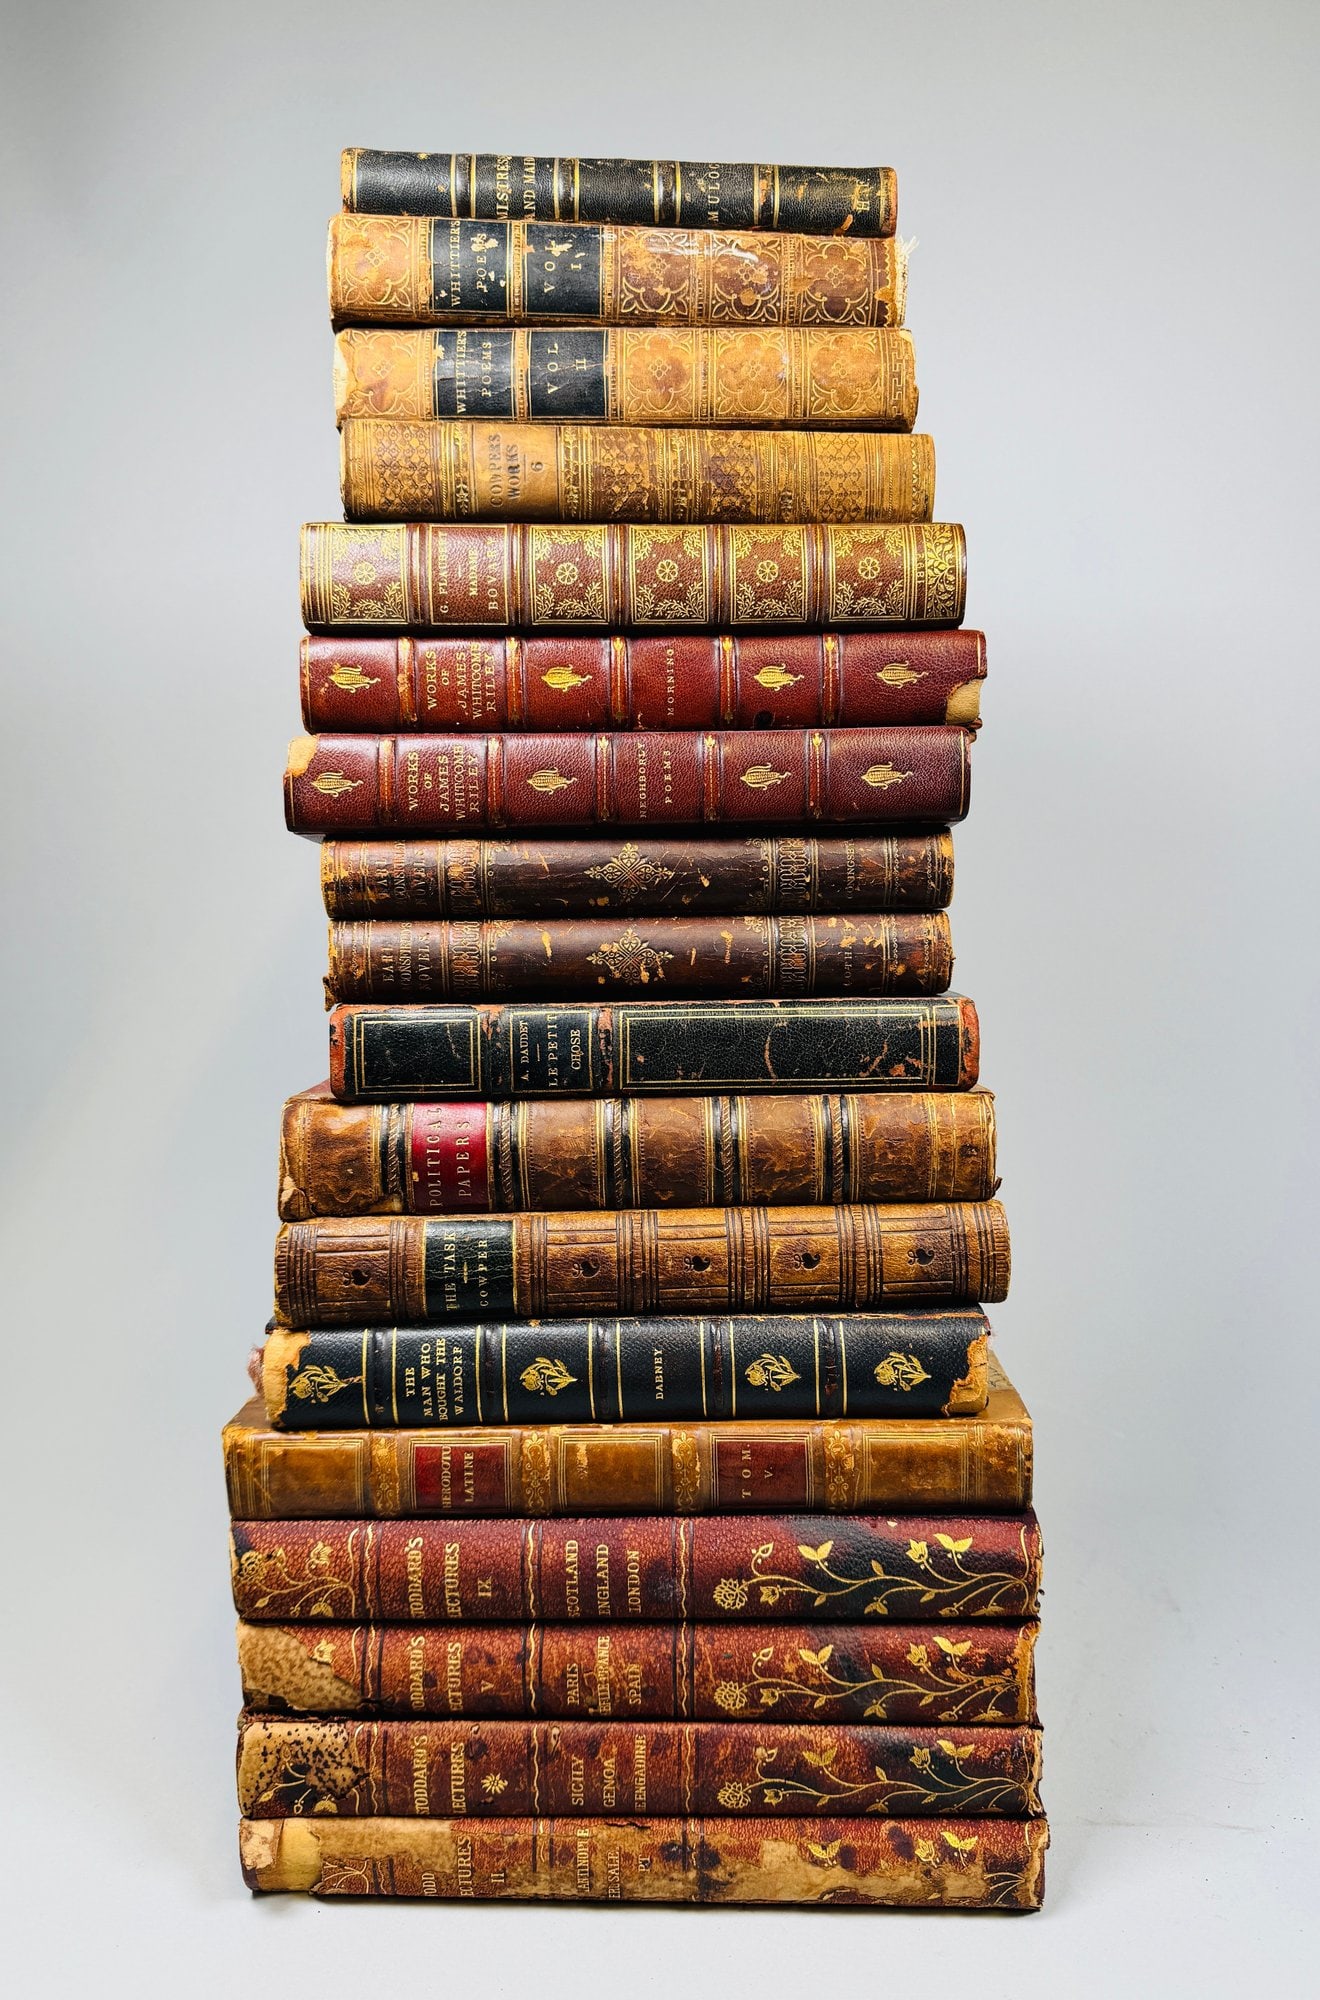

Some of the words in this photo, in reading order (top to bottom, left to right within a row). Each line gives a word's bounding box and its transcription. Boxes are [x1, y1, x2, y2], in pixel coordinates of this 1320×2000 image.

[523, 189, 535, 220] AND
[450, 220, 460, 306] WHITTIER'S
[456, 330, 466, 413] WHITTIER'S
[482, 342, 491, 397] POEMS
[548, 343, 559, 394] VOL
[576, 359, 587, 371] II
[507, 444, 520, 500] WORKS
[531, 461, 543, 472] 6
[438, 531, 448, 595] FLAUBERT
[469, 549, 478, 597] MADAME
[486, 537, 499, 610] BOVARY
[426, 650, 437, 710] WORKS
[442, 669, 449, 685] OF
[456, 652, 467, 709] JAMES
[470, 643, 482, 719] WHITCOMB
[484, 652, 496, 711] RILEY
[408, 751, 419, 810] WORKS
[424, 773, 432, 789] OF
[438, 755, 450, 812] JAMES
[453, 745, 466, 820] WHITCOMB
[469, 755, 480, 812] RILEY
[664, 750, 673, 803] POEMS
[519, 1020, 529, 1064] DAUDET
[547, 1014, 558, 1060] PETIT
[570, 1029, 581, 1070] CHOSE
[520, 1070, 529, 1081] A.
[548, 1067, 558, 1086] LE
[427, 1108, 443, 1206] POLITICAL
[456, 1121, 471, 1196] PAPERS
[443, 1231, 455, 1273] TASK
[478, 1240, 488, 1307] COWPER
[445, 1283, 458, 1311] THE
[421, 1343, 431, 1379] WHO
[436, 1338, 446, 1365] THE
[654, 1348, 664, 1400] DABNEY
[405, 1367, 415, 1397] THE
[422, 1386, 433, 1417] MAN
[436, 1373, 448, 1421] BOUGHT
[453, 1346, 464, 1415] WALDORF
[464, 1451, 474, 1503] LATINE
[478, 1576, 491, 1598] IX
[566, 1540, 580, 1617] SCOTLAND
[596, 1544, 610, 1616] ENGLAND
[627, 1549, 641, 1613] LONDON
[481, 1680, 494, 1693] V
[566, 1663, 579, 1705] PARIS
[629, 1663, 642, 1705] SPAIN
[451, 1742, 466, 1814] LECTURES
[571, 1756, 584, 1806] SICILY
[603, 1758, 616, 1807] GENOA
[634, 1734, 646, 1801] ENGADINE
[491, 1873, 505, 1883] II
